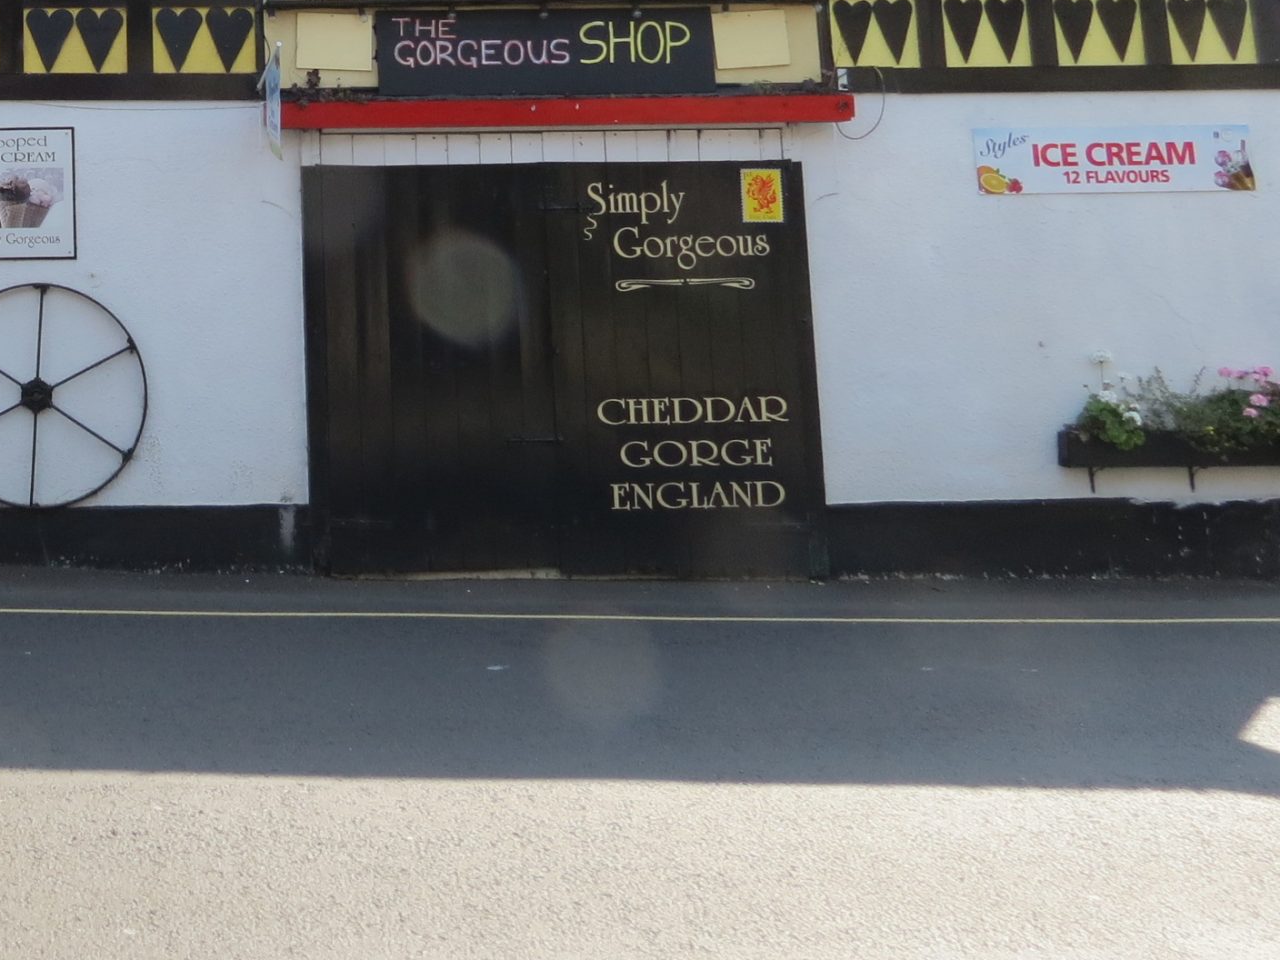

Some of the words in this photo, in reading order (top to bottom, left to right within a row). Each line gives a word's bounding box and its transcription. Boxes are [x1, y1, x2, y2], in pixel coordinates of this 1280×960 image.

[392, 17, 457, 39] THE
[394, 39, 571, 69] GORGEOUS
[579, 20, 691, 65] SHOP
[0, 151, 56, 163] CREAM
[979, 131, 1029, 158] Styles
[1032, 143, 1077, 168] ICE
[1085, 141, 1196, 167] CREAM
[1063, 170, 1081, 185] 12
[1086, 169, 1170, 184] FLAVOURS
[586, 180, 685, 225] Simply
[6, 233, 61, 249] Gorgeous
[613, 227, 771, 270] Gorgeous
[596, 396, 790, 425] CHEDDAR
[620, 438, 774, 468] GORGE
[610, 480, 786, 511] ENGLAND
